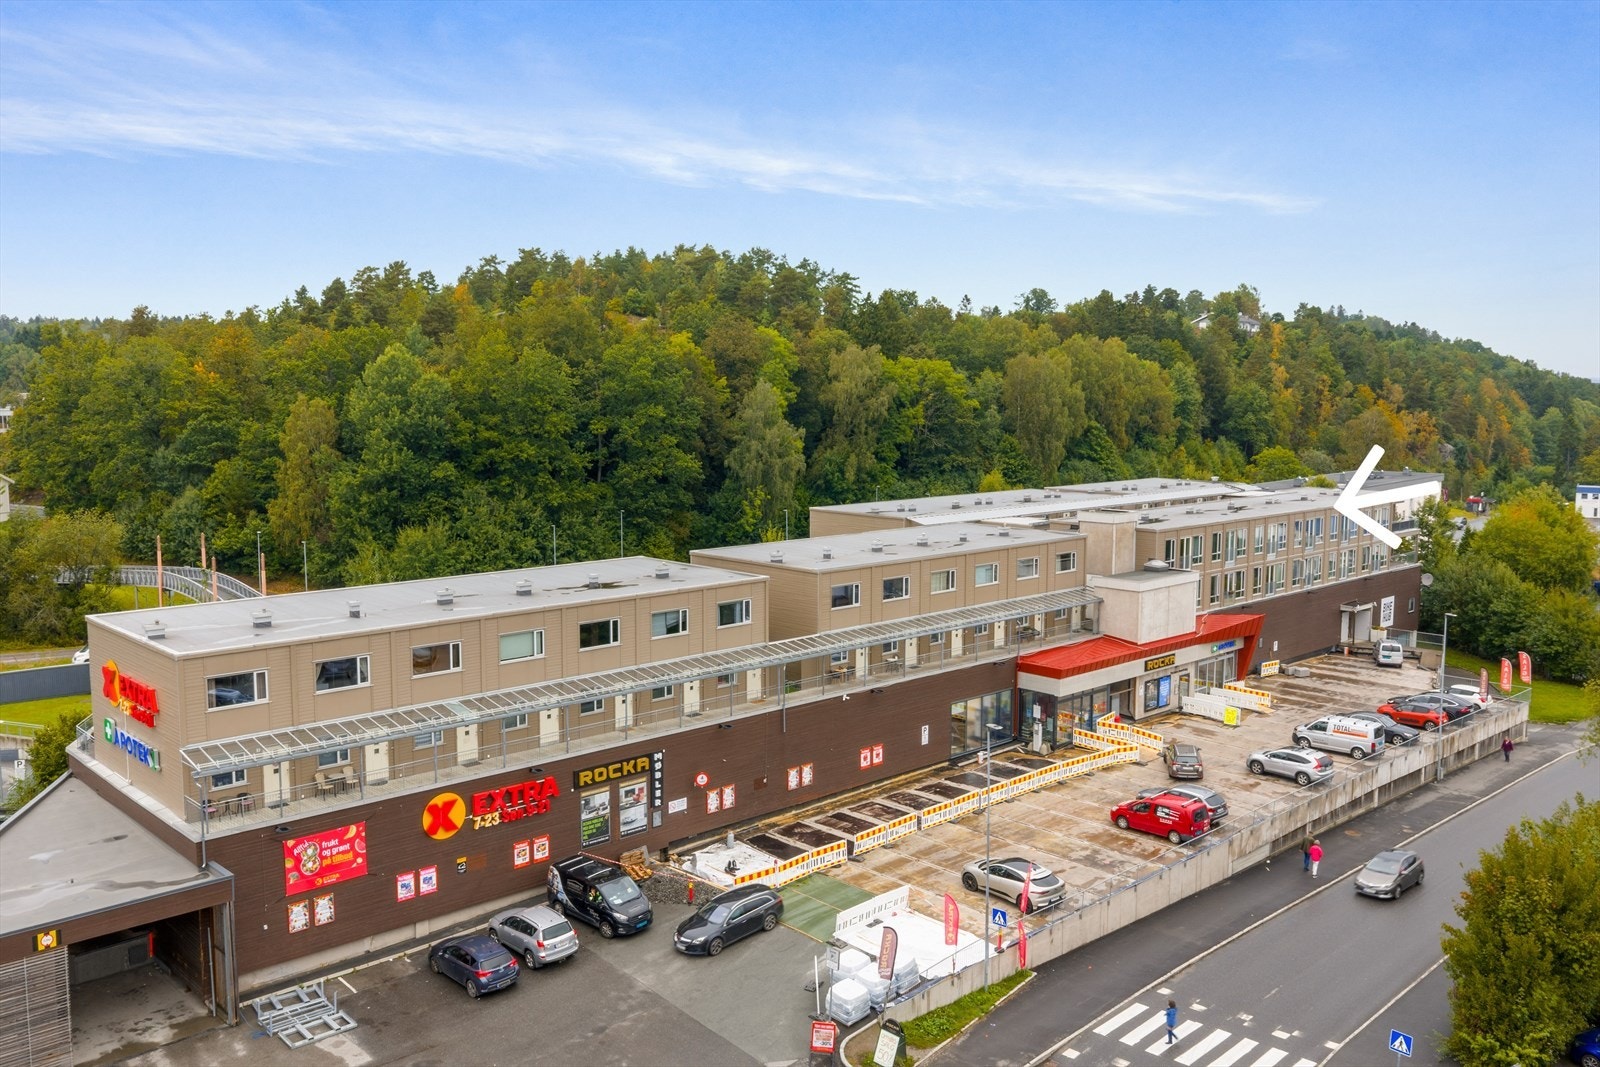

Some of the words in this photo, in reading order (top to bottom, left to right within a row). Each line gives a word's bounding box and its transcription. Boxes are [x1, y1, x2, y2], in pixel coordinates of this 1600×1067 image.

[1146, 655, 1176, 671] ROCKA
[1333, 724, 1351, 732] TOTAL
[114, 727, 151, 768] APOTEK
[16, 760, 23, 768] P
[578, 757, 650, 787] ROCKA
[653, 752, 663, 807] MØBLER
[471, 776, 559, 816] EXTRA
[473, 811, 500, 830] 7-23
[321, 838, 339, 849] frukt
[321, 848, 332, 857] og
[332, 843, 351, 856] grønt
